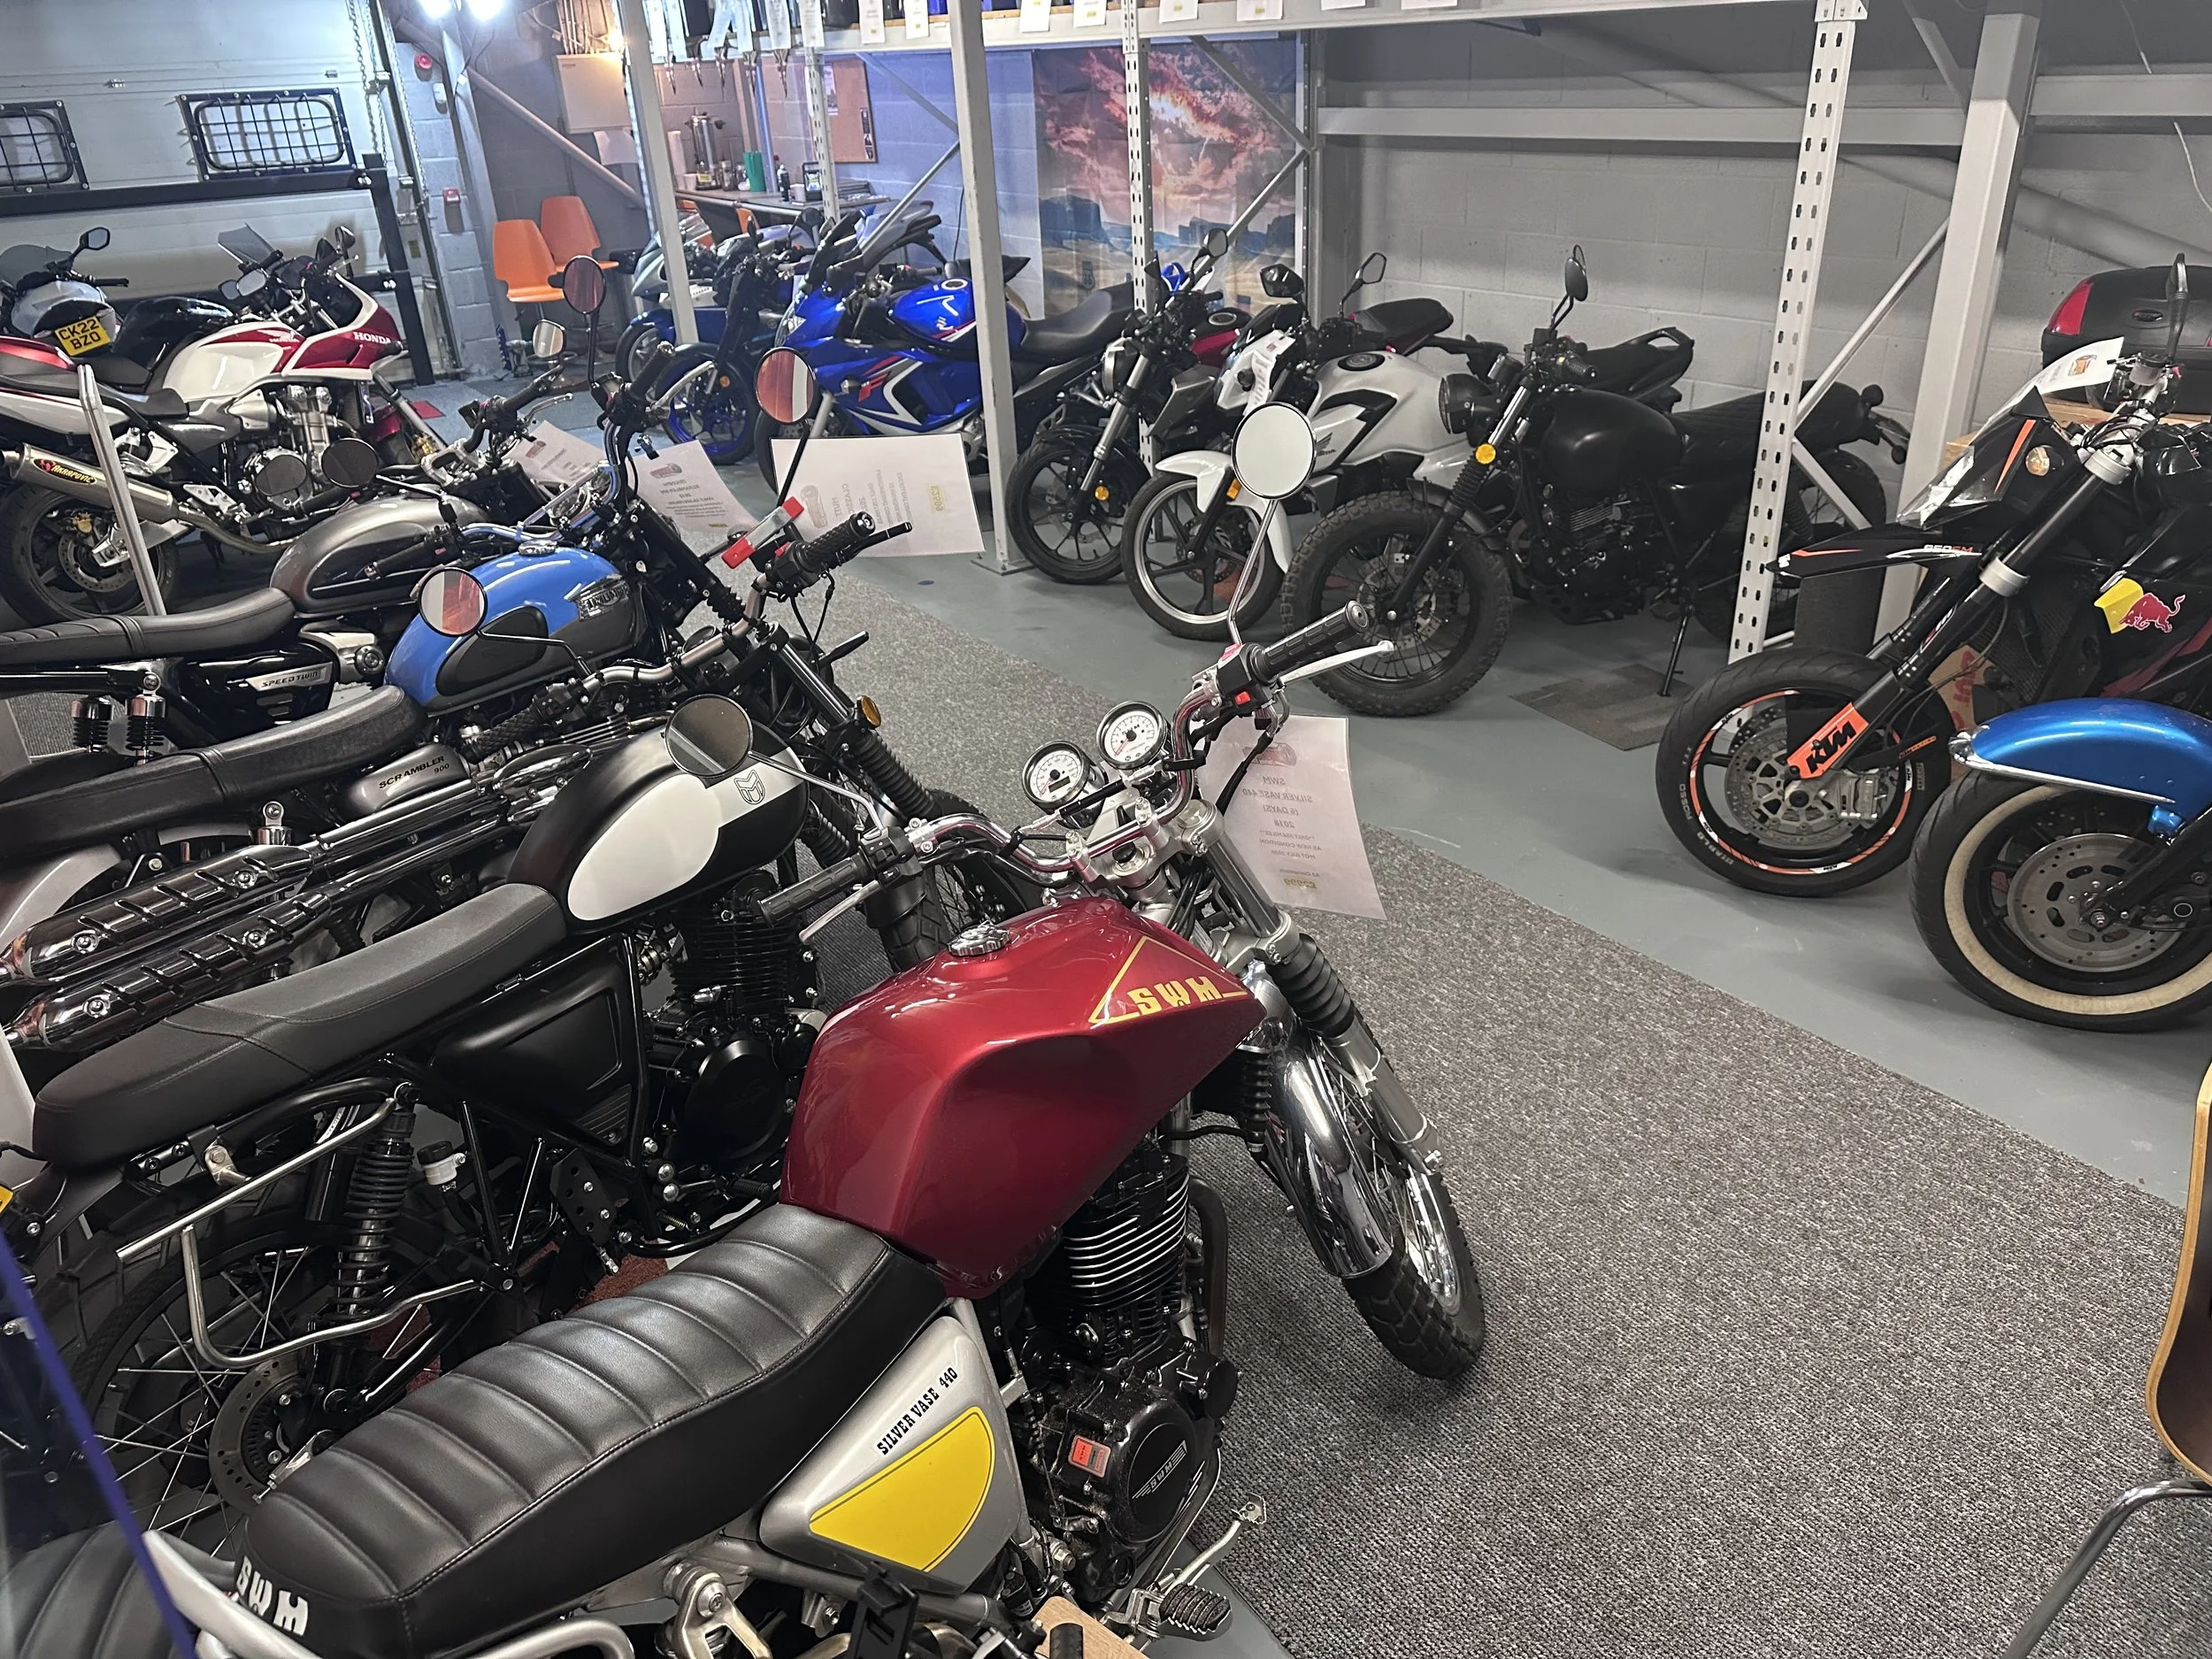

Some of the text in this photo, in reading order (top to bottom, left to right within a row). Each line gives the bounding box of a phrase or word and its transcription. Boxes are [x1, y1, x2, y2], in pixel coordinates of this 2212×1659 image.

[58, 319, 99, 340] CK22
[70, 331, 101, 349] BZO
[353, 332, 391, 344] HONDA
[262, 676, 295, 687] SPEED
[1806, 721, 1856, 774] KTM
[379, 756, 444, 788] SCRAMBLER
[434, 763, 449, 774] 900
[1127, 976, 1223, 1016] SWM
[877, 1367, 958, 1455] SILVER VASE 440
[1150, 1462, 1173, 1489] SWM
[236, 1555, 309, 1636] SWM
